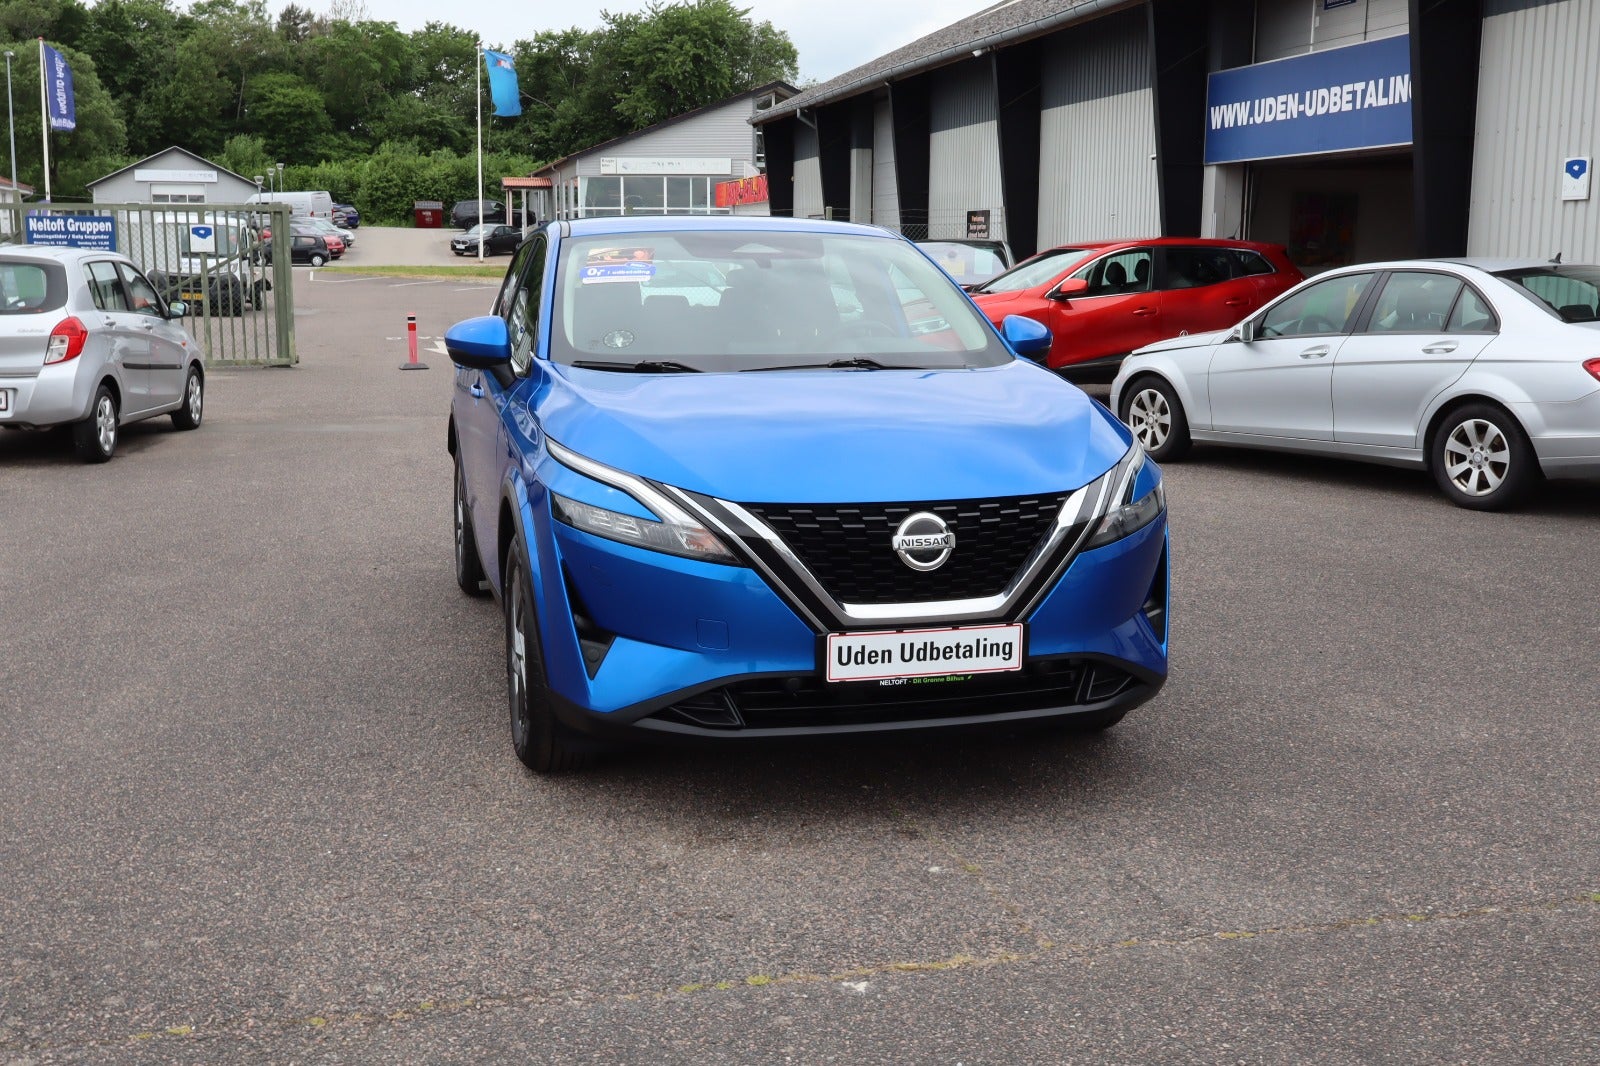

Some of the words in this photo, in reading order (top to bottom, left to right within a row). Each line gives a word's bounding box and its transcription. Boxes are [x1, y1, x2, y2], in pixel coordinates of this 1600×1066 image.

[1210, 73, 1412, 130] WWW.UDEN-UDBETALIN
[28, 218, 65, 232] Neltoft
[67, 218, 112, 234] Gruppen
[901, 536, 950, 548] NISSAN
[836, 644, 893, 667] Uden
[899, 637, 1014, 664] Udbetaling
[879, 678, 908, 687] NELTOFT
